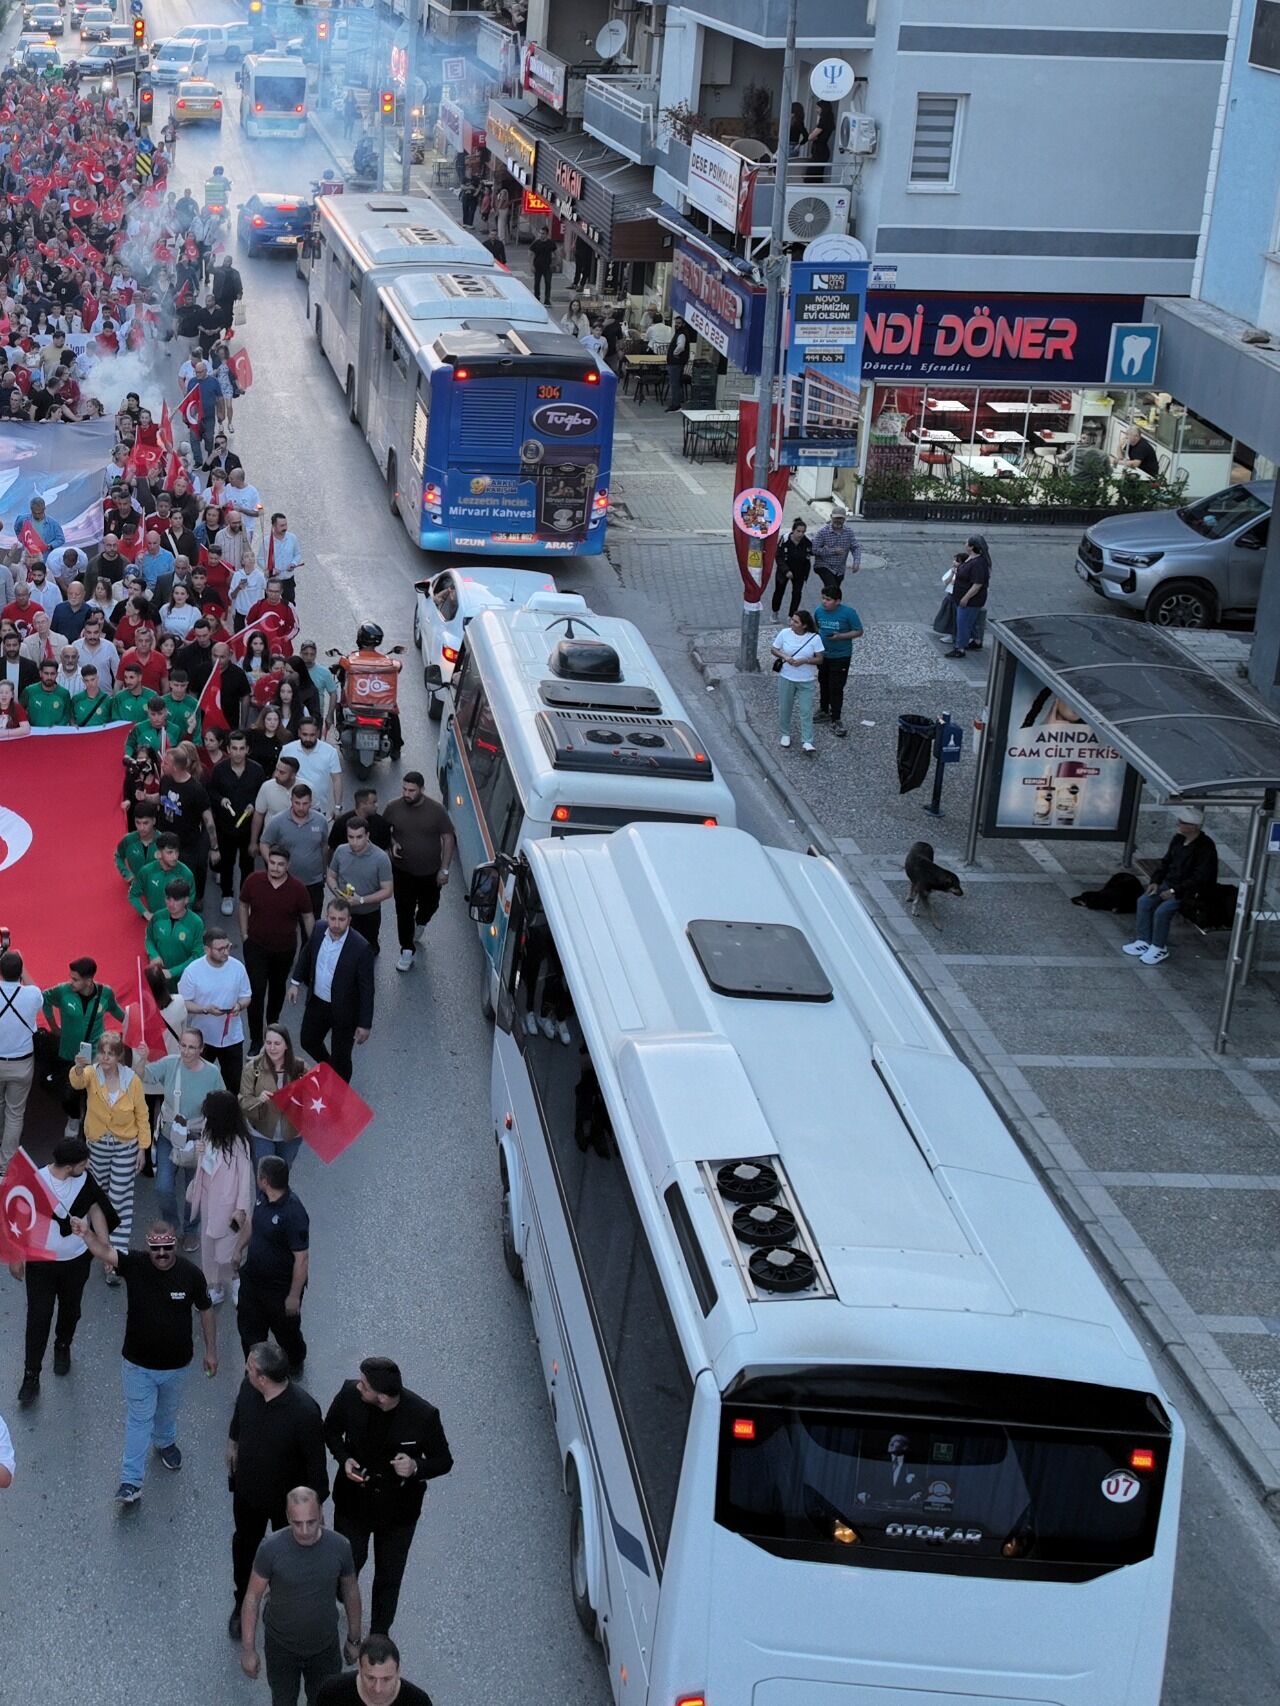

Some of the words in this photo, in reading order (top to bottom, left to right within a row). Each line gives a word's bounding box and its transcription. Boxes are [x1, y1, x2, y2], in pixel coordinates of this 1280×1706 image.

[691, 153, 708, 174] DESE
[804, 302, 850, 311] HEPİMİZİN
[803, 311, 817, 320] EVİ
[818, 312, 850, 320] OLSUN!
[691, 312, 704, 332] 452
[710, 328, 725, 349] 222
[864, 304, 925, 355] NDİ
[933, 306, 1078, 360] DÖNER
[863, 361, 913, 371] Dönerin
[920, 362, 971, 373] Efendisi
[538, 385, 560, 399] 304
[449, 506, 490, 516] Mirvari
[493, 508, 536, 518] Kahvesi
[455, 538, 485, 547] UZUN
[545, 542, 574, 551] ARAÇ
[1035, 731, 1099, 744] ANINDA
[1008, 747, 1040, 758] CAM
[1044, 744, 1074, 759] CİLT
[1078, 745, 1123, 760] ETKİS
[885, 1521, 983, 1544] OTOKAR
